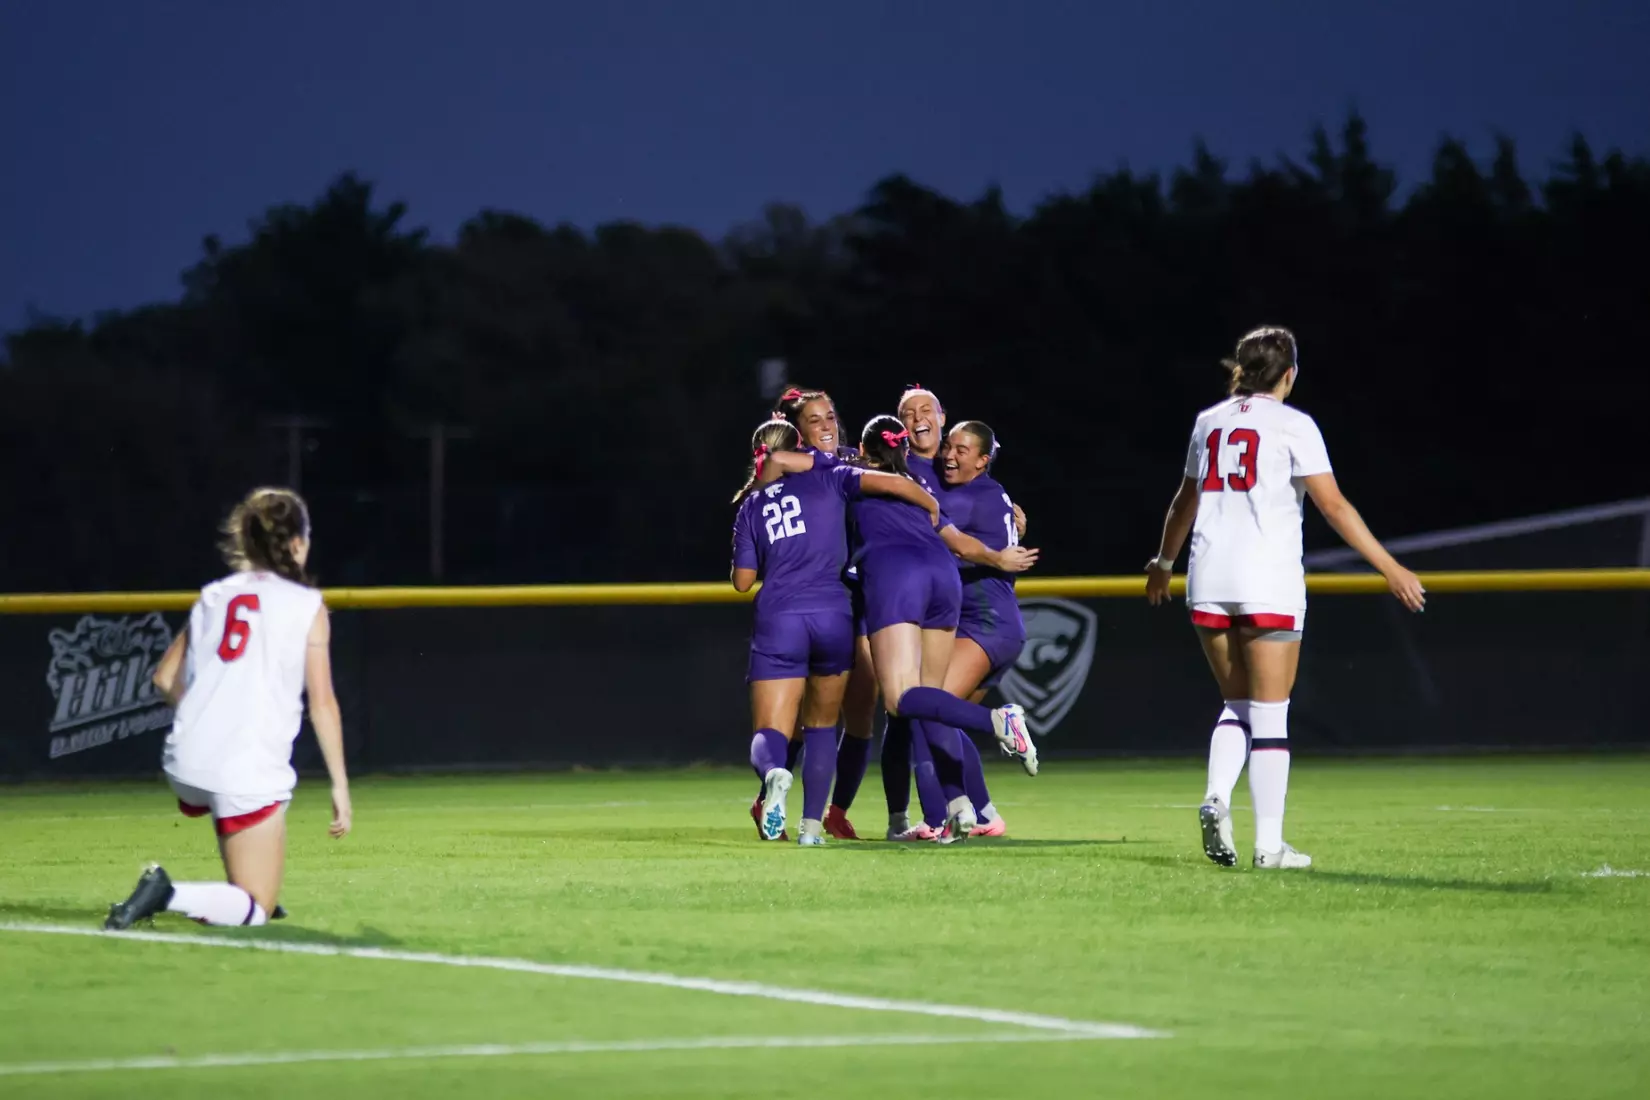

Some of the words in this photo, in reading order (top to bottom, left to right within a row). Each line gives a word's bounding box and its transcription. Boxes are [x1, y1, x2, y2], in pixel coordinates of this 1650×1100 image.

[1202, 428, 1260, 492] 13
[762, 495, 806, 545] 22
[217, 594, 260, 662] 6
